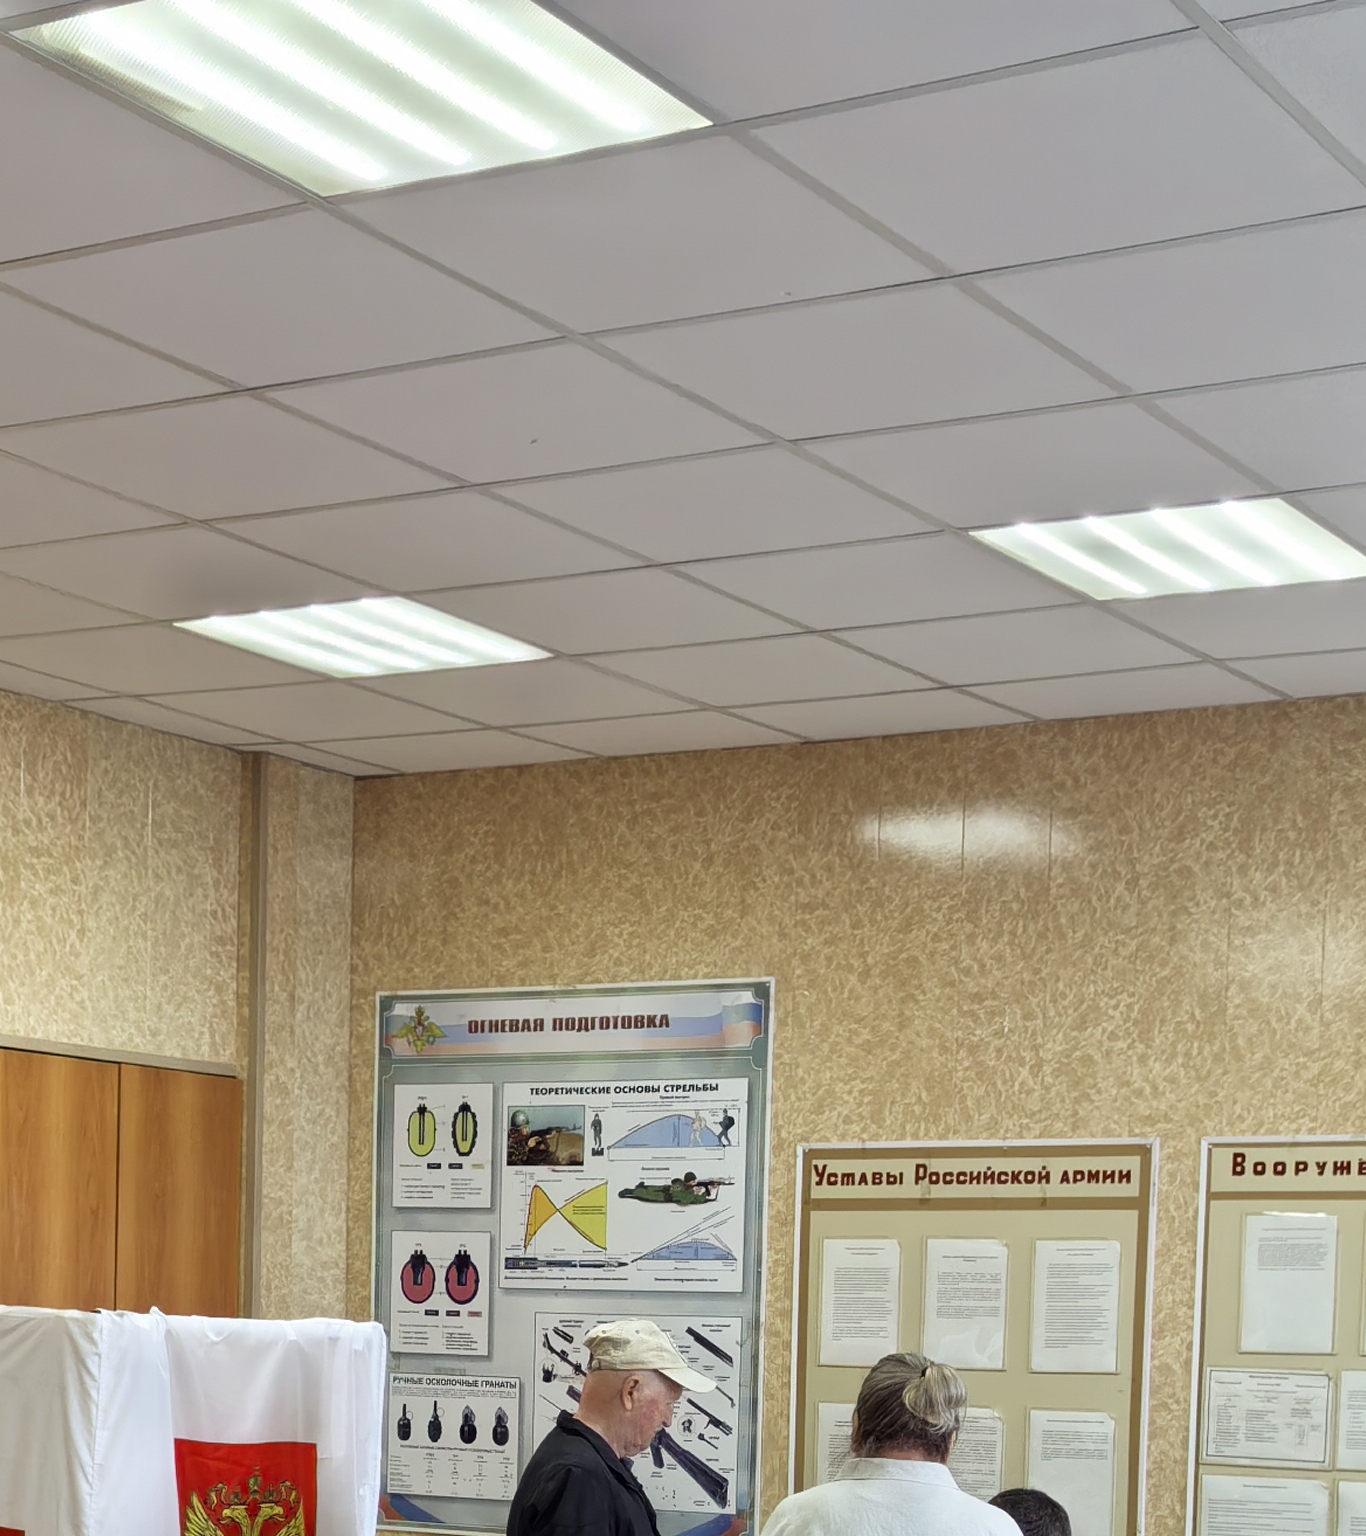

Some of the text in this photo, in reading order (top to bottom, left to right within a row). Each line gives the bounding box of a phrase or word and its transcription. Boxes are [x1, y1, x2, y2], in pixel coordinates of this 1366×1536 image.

[467, 1014, 671, 1034] ОГНЕВАЯ ПОДГОТОВКА
[530, 1083, 719, 1096] ТЕОРЕТИЧЕСКИЕ ОСНОВЫ СТРЕЛЬБЫ
[914, 1163, 1051, 1186] Российской
[392, 1376, 517, 1389] РУЧНЫЕ ОСКОЛОЧНЫЕ ГРАНАТЫ
